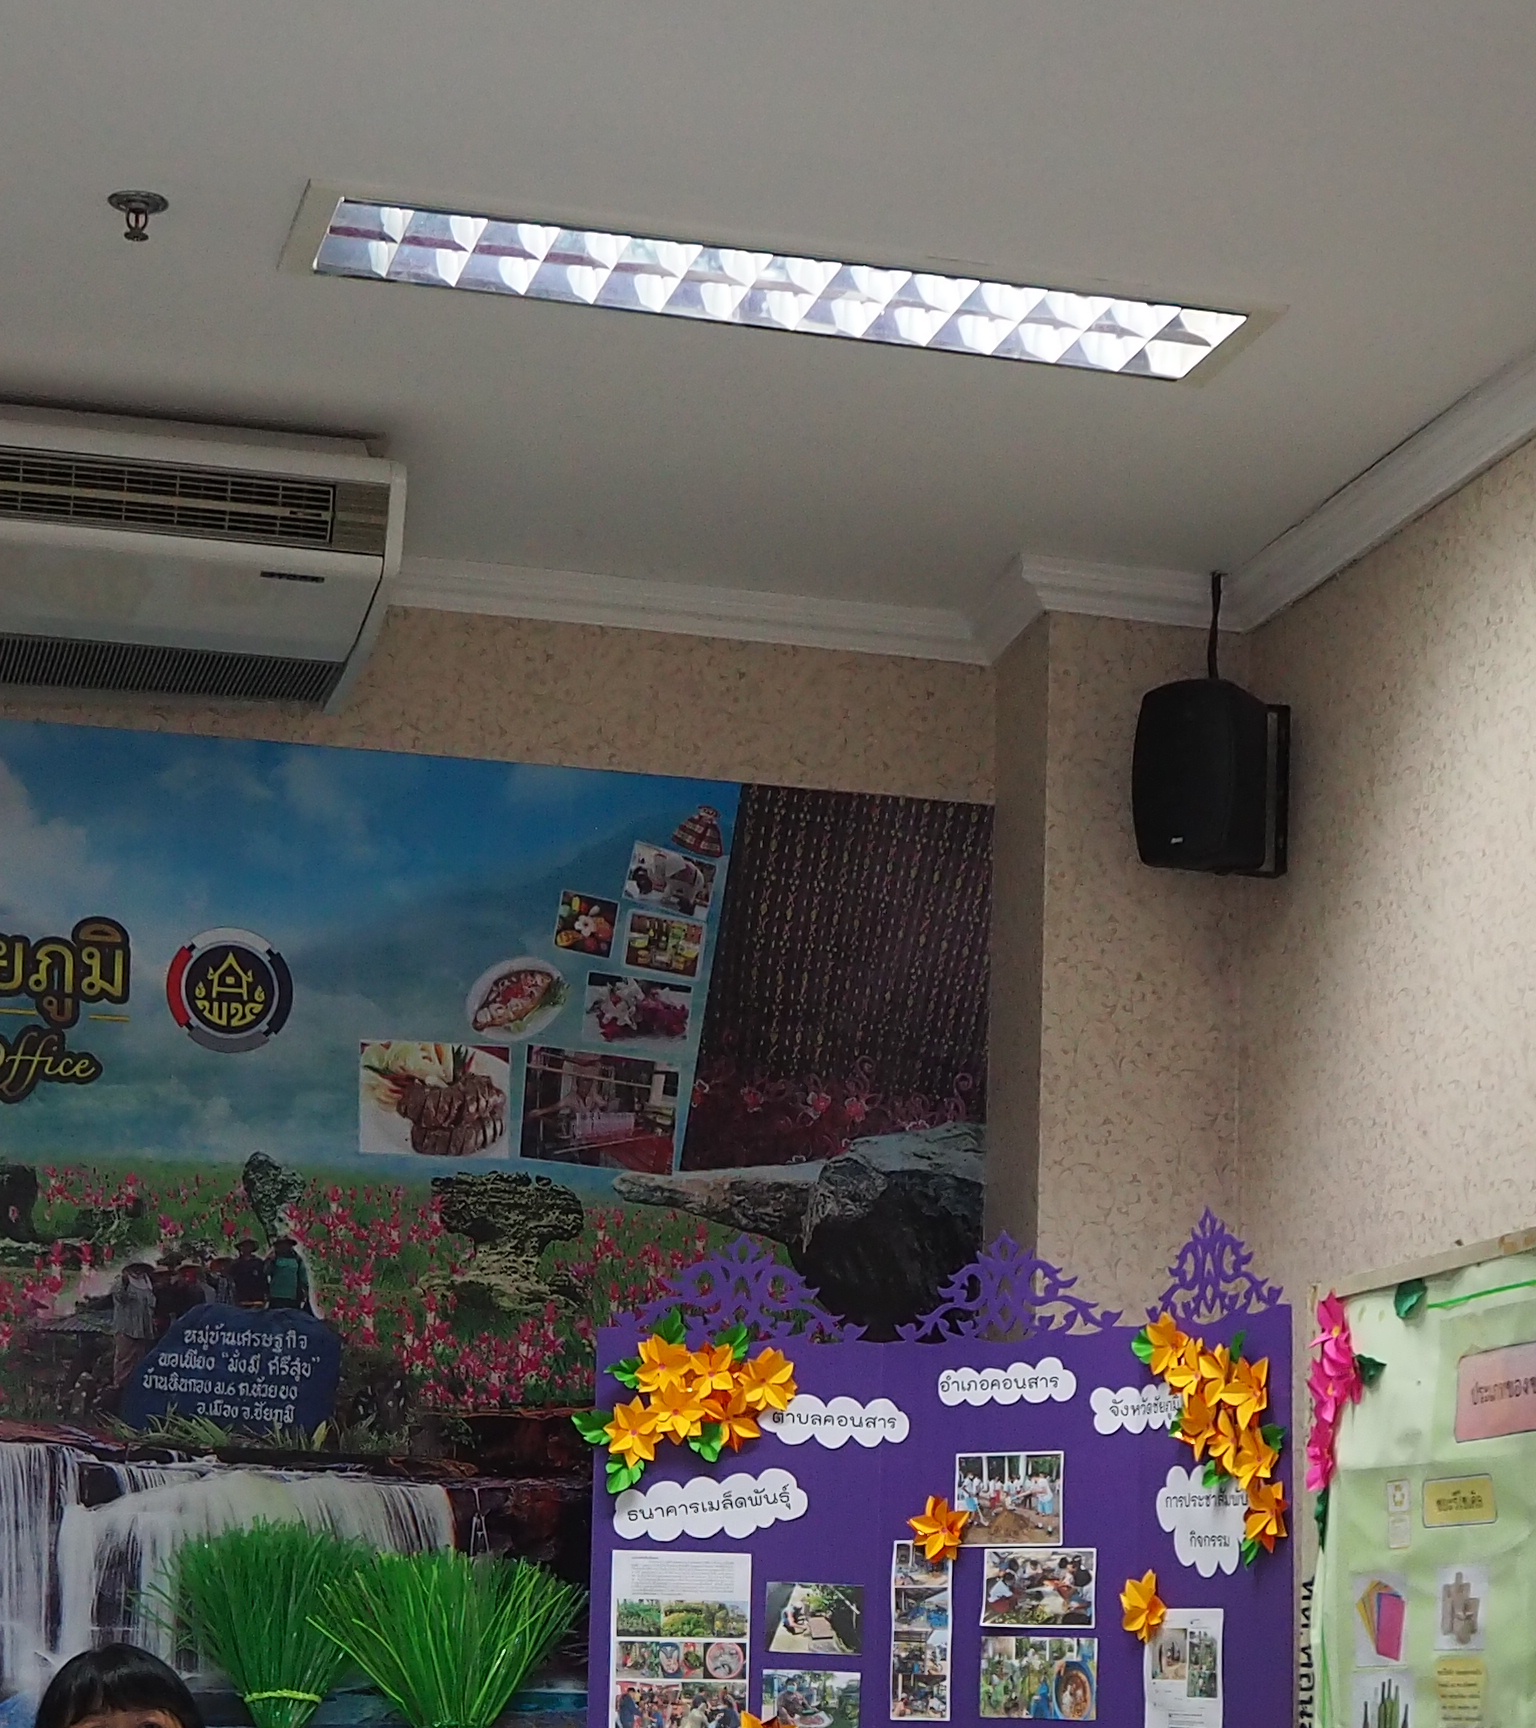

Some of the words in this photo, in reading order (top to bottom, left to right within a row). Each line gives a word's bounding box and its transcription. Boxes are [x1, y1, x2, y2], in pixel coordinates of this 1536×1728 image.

[183, 1324, 308, 1353] หมู่บ้านเศรษฐกิจ
[939, 1371, 1060, 1394] อำเภอคอนสาร
[627, 1483, 792, 1522] ธนาคารเมล็ดพันธุ์
[1189, 1530, 1231, 1548] กิจกรรม
